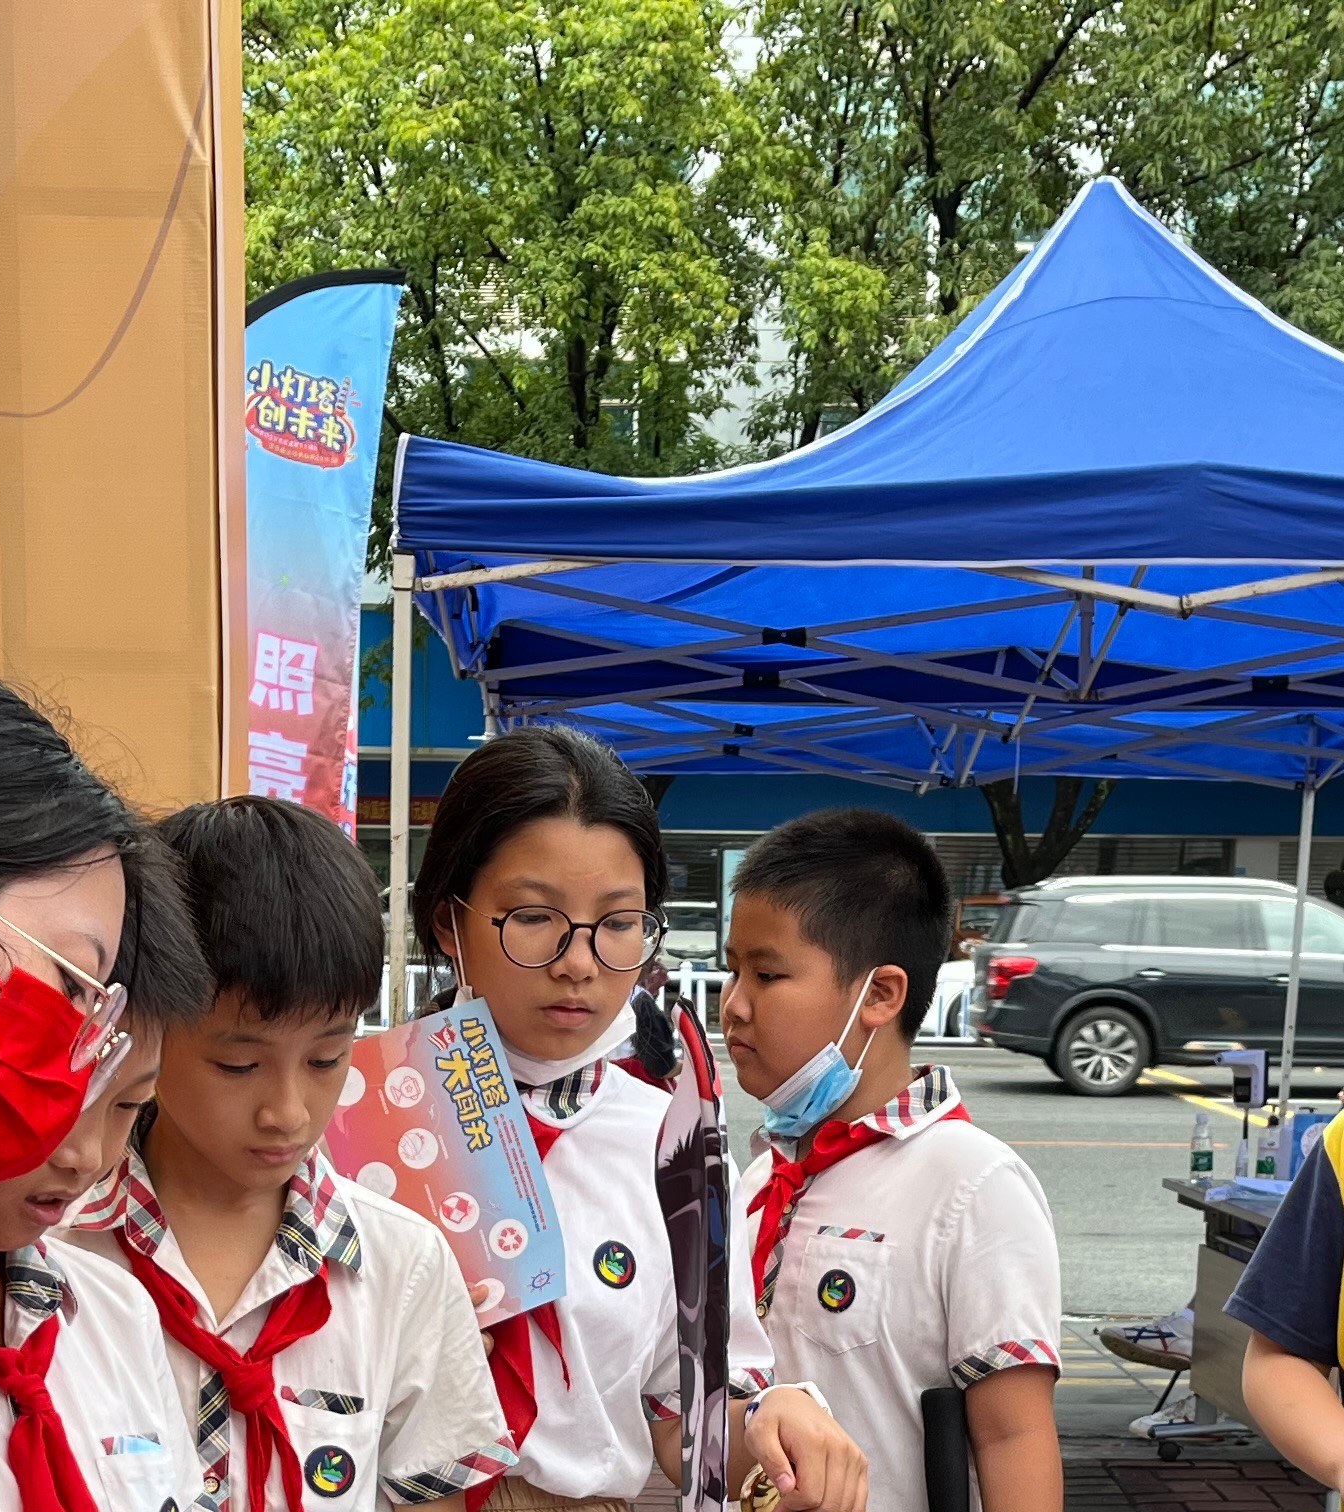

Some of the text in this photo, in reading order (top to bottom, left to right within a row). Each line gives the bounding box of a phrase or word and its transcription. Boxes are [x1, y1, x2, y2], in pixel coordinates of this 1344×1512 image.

[248, 359, 339, 415] 小灯塔
[257, 395, 346, 453] 创未来
[435, 1048, 493, 1152] 大闯关
[460, 1018, 509, 1109] 小灯塔
